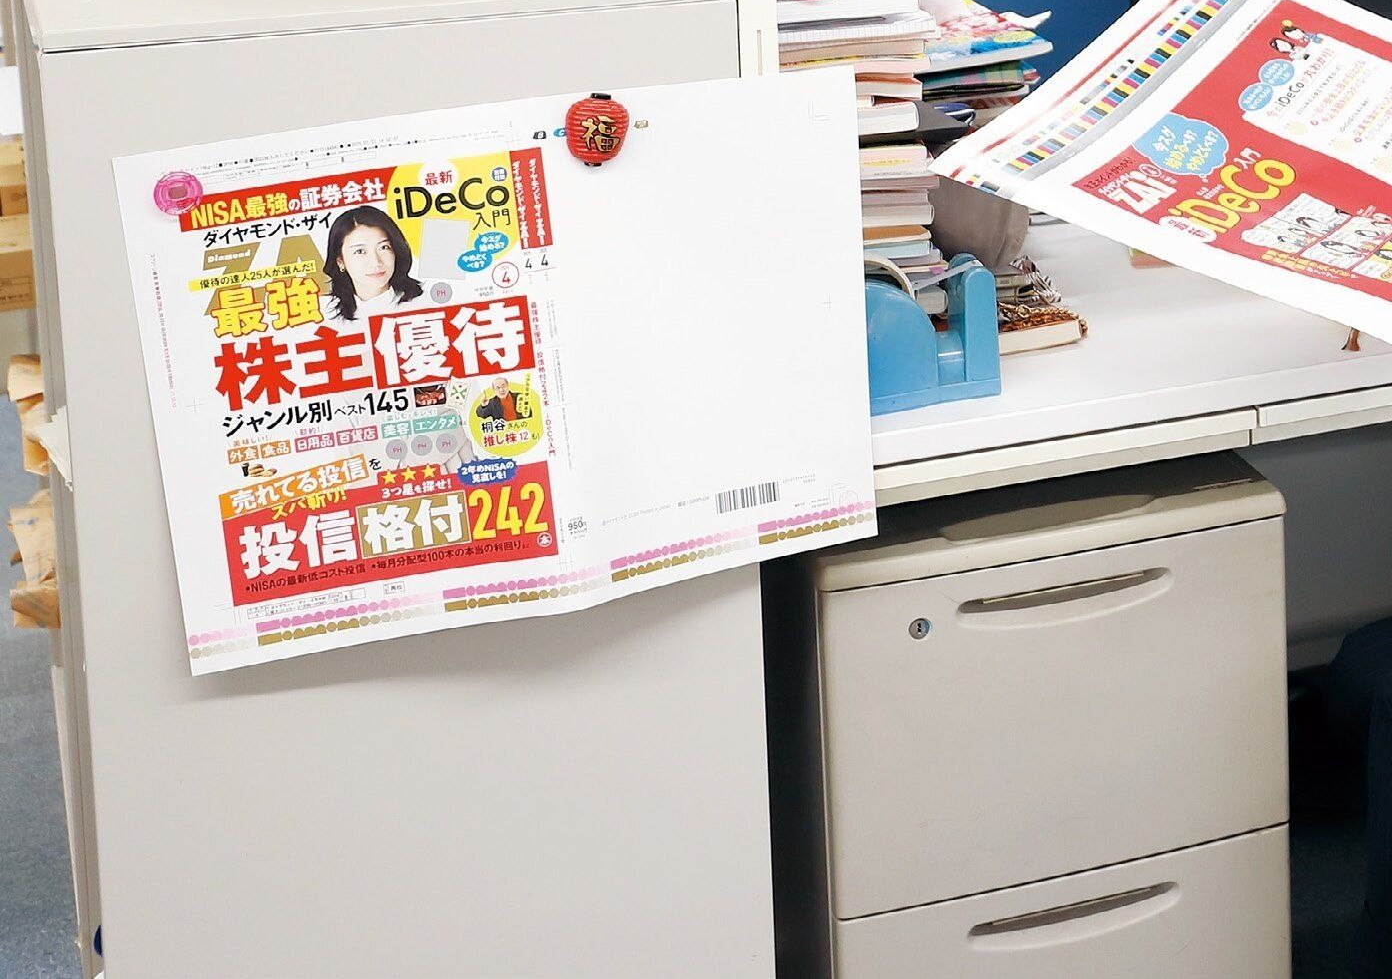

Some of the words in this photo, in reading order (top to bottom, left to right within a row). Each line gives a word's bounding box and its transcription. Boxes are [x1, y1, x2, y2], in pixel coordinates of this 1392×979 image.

[580, 115, 620, 153] 福
[425, 171, 453, 186] 最新
[190, 176, 386, 229] NISA最強の証券会社
[394, 177, 511, 219] iDeCo
[1168, 159, 1297, 234] iDeCo
[203, 212, 333, 248] ダイヤモンド・ザイ
[472, 208, 511, 230] 入門
[207, 249, 251, 264] Diamond
[525, 258, 533, 269] 4
[540, 254, 549, 267] 4
[199, 262, 315, 290] 優待の達人25人が選んだ!
[502, 271, 511, 284] 4
[211, 277, 325, 337] 最強
[214, 303, 527, 412] 株主優待
[222, 388, 409, 438] ジャンル別ベスト145
[481, 419, 528, 434] 桐谷さんの
[229, 446, 259, 463] 外食
[262, 442, 290, 458] 食品
[297, 434, 334, 451] 日用品
[338, 427, 377, 445] 百貨店
[384, 423, 411, 437] 美容
[415, 416, 458, 430] エンタメ
[230, 458, 382, 511] 売れてる投信を
[381, 477, 452, 499] 3つ星を探せ!
[271, 486, 348, 520] ズバ斬り!
[239, 495, 465, 579] 投信格付
[469, 482, 549, 541] 242
[250, 563, 366, 594] NISAの最新低コスト投信
